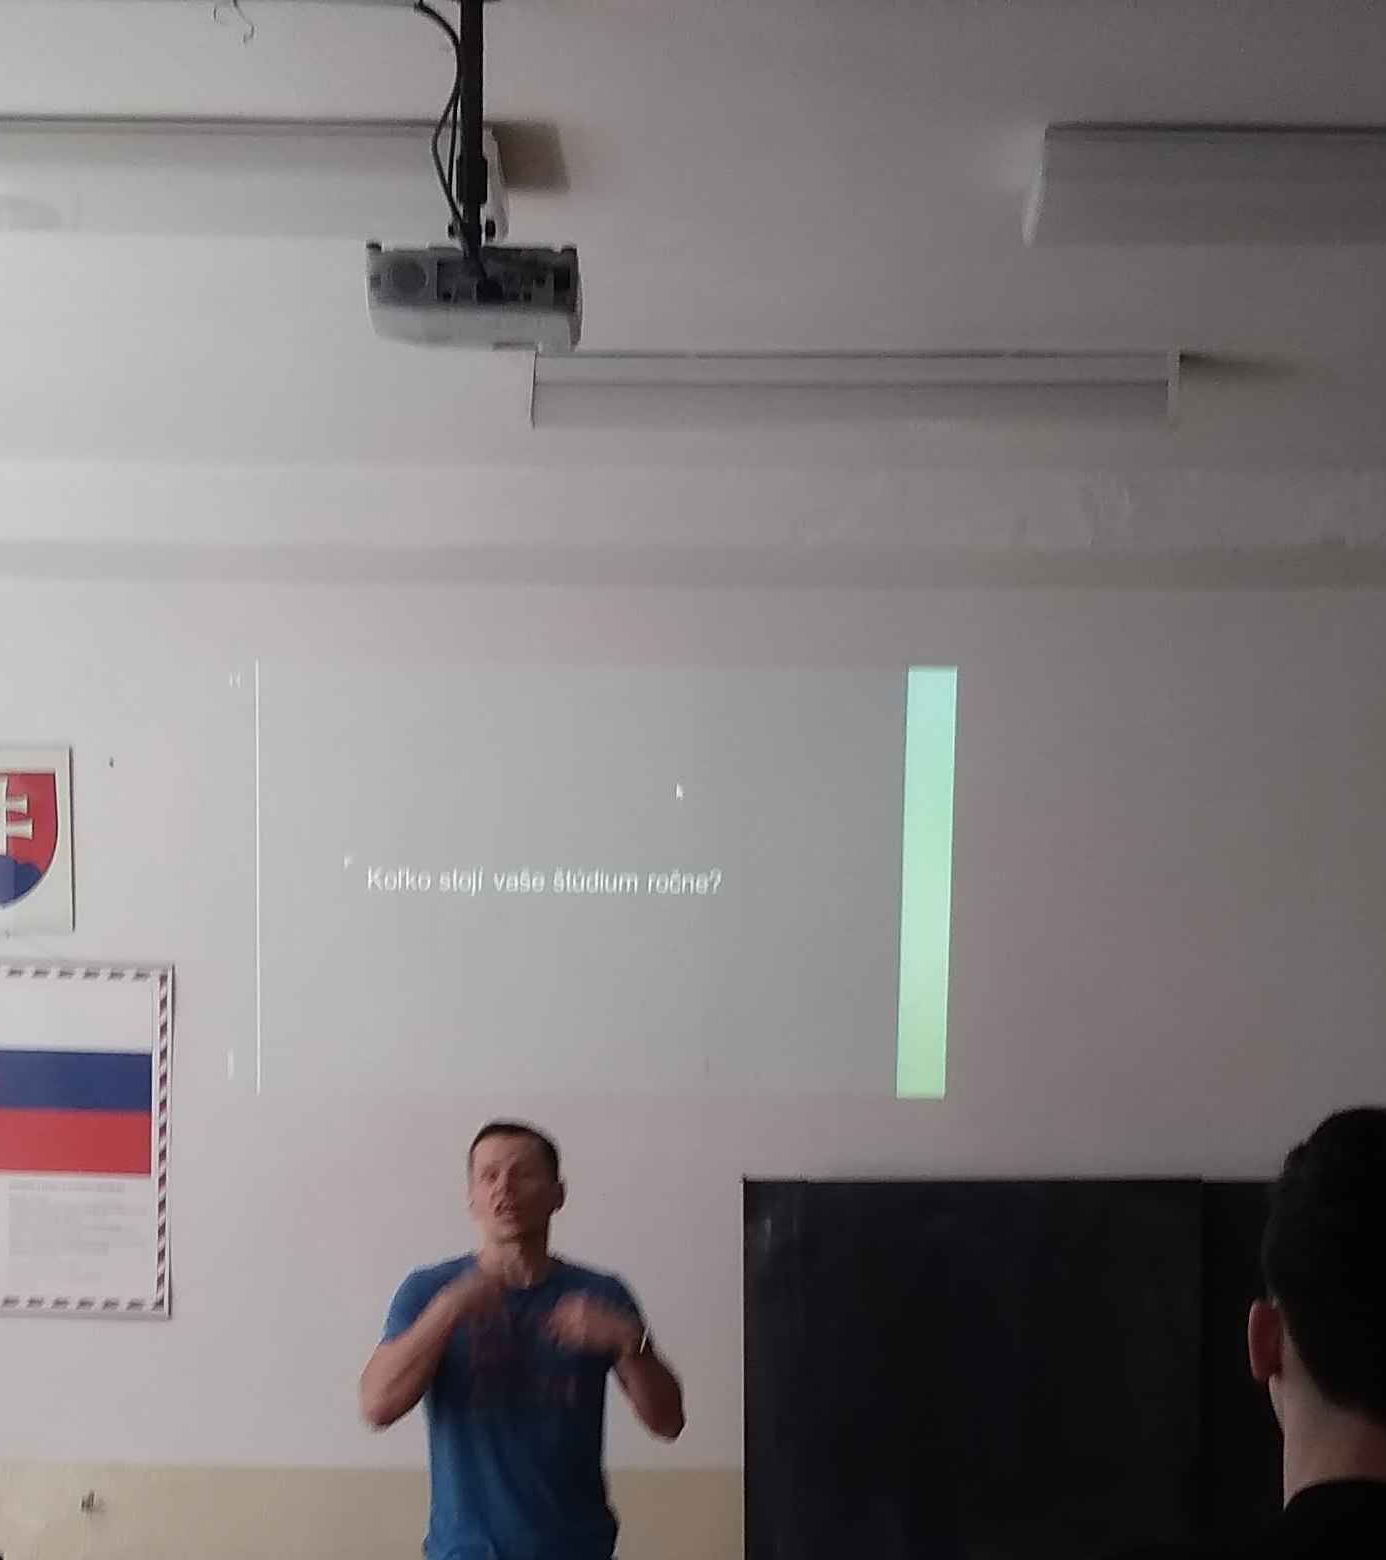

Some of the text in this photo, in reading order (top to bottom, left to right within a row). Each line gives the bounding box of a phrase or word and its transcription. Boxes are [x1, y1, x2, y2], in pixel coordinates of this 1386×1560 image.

[366, 865, 722, 896] Koľko stojí vaše štúdium ročne?
